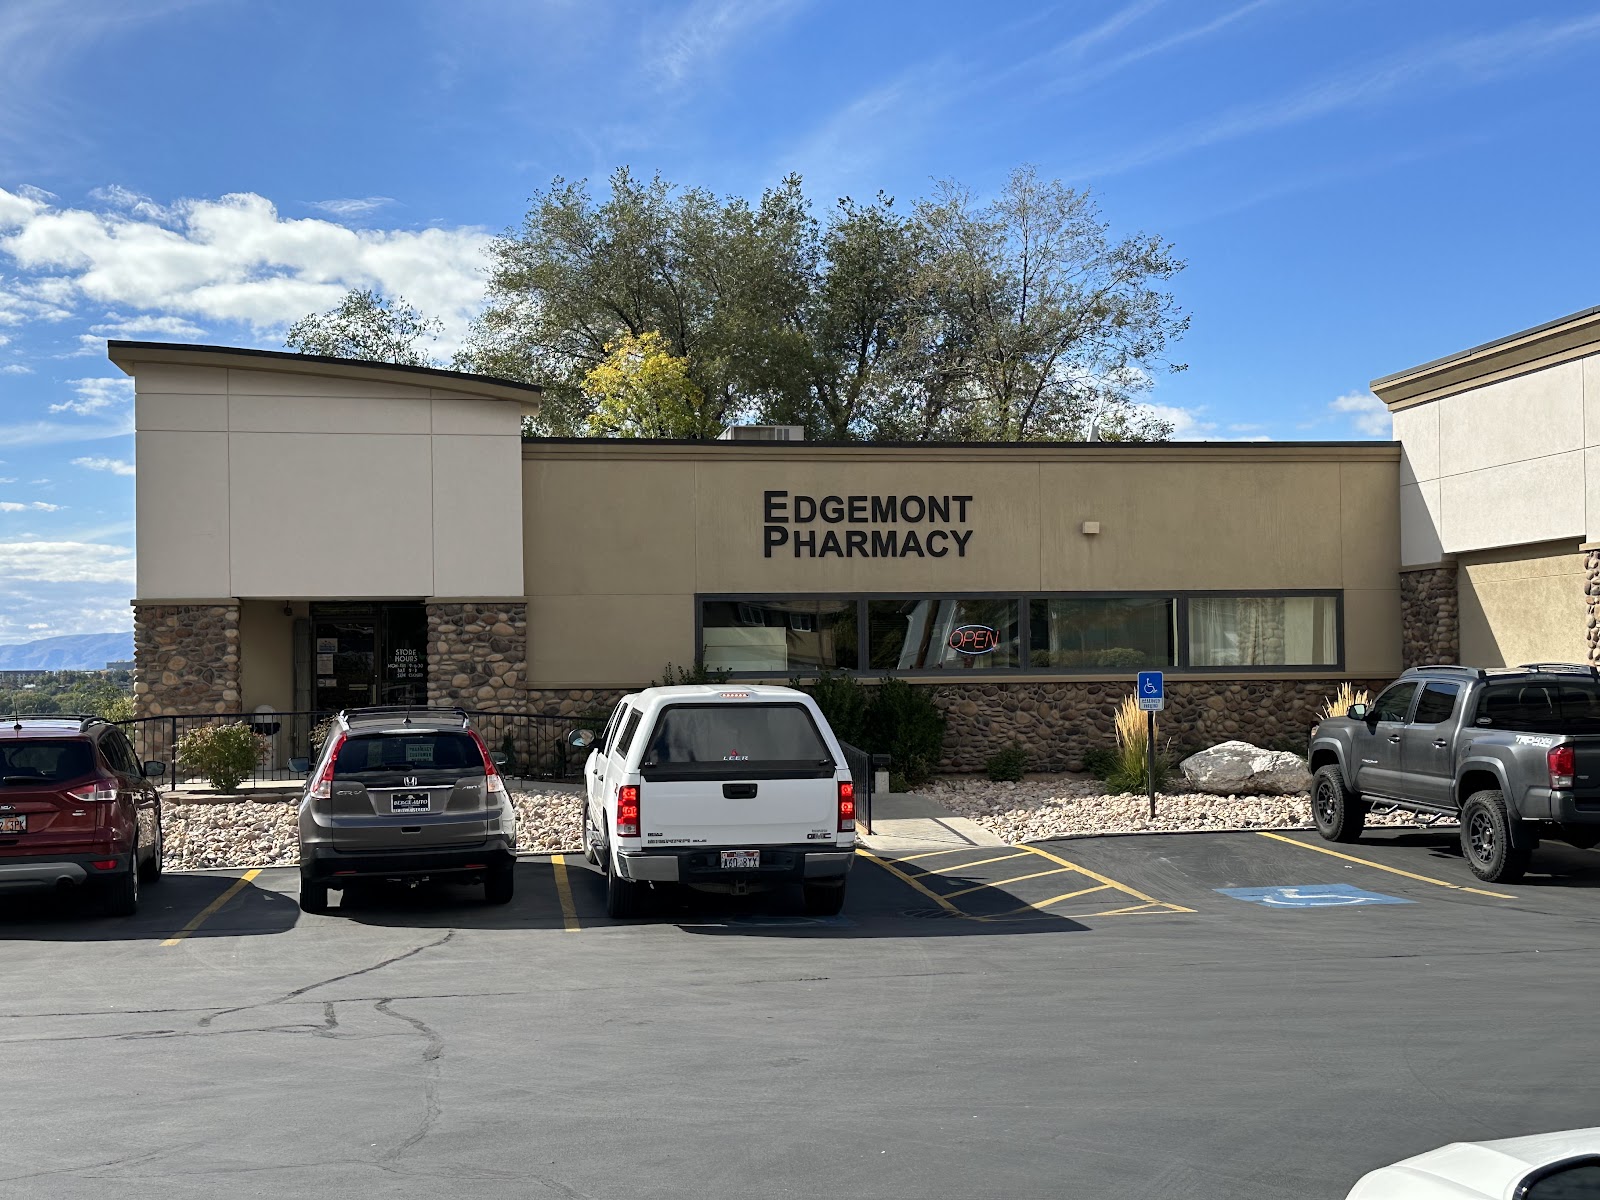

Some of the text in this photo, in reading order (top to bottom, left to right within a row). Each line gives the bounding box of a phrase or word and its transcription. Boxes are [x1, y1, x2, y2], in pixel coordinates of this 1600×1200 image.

[764, 490, 973, 523] EDGEMONT
[764, 525, 973, 558] PHARMACY
[950, 630, 999, 648] OPEN
